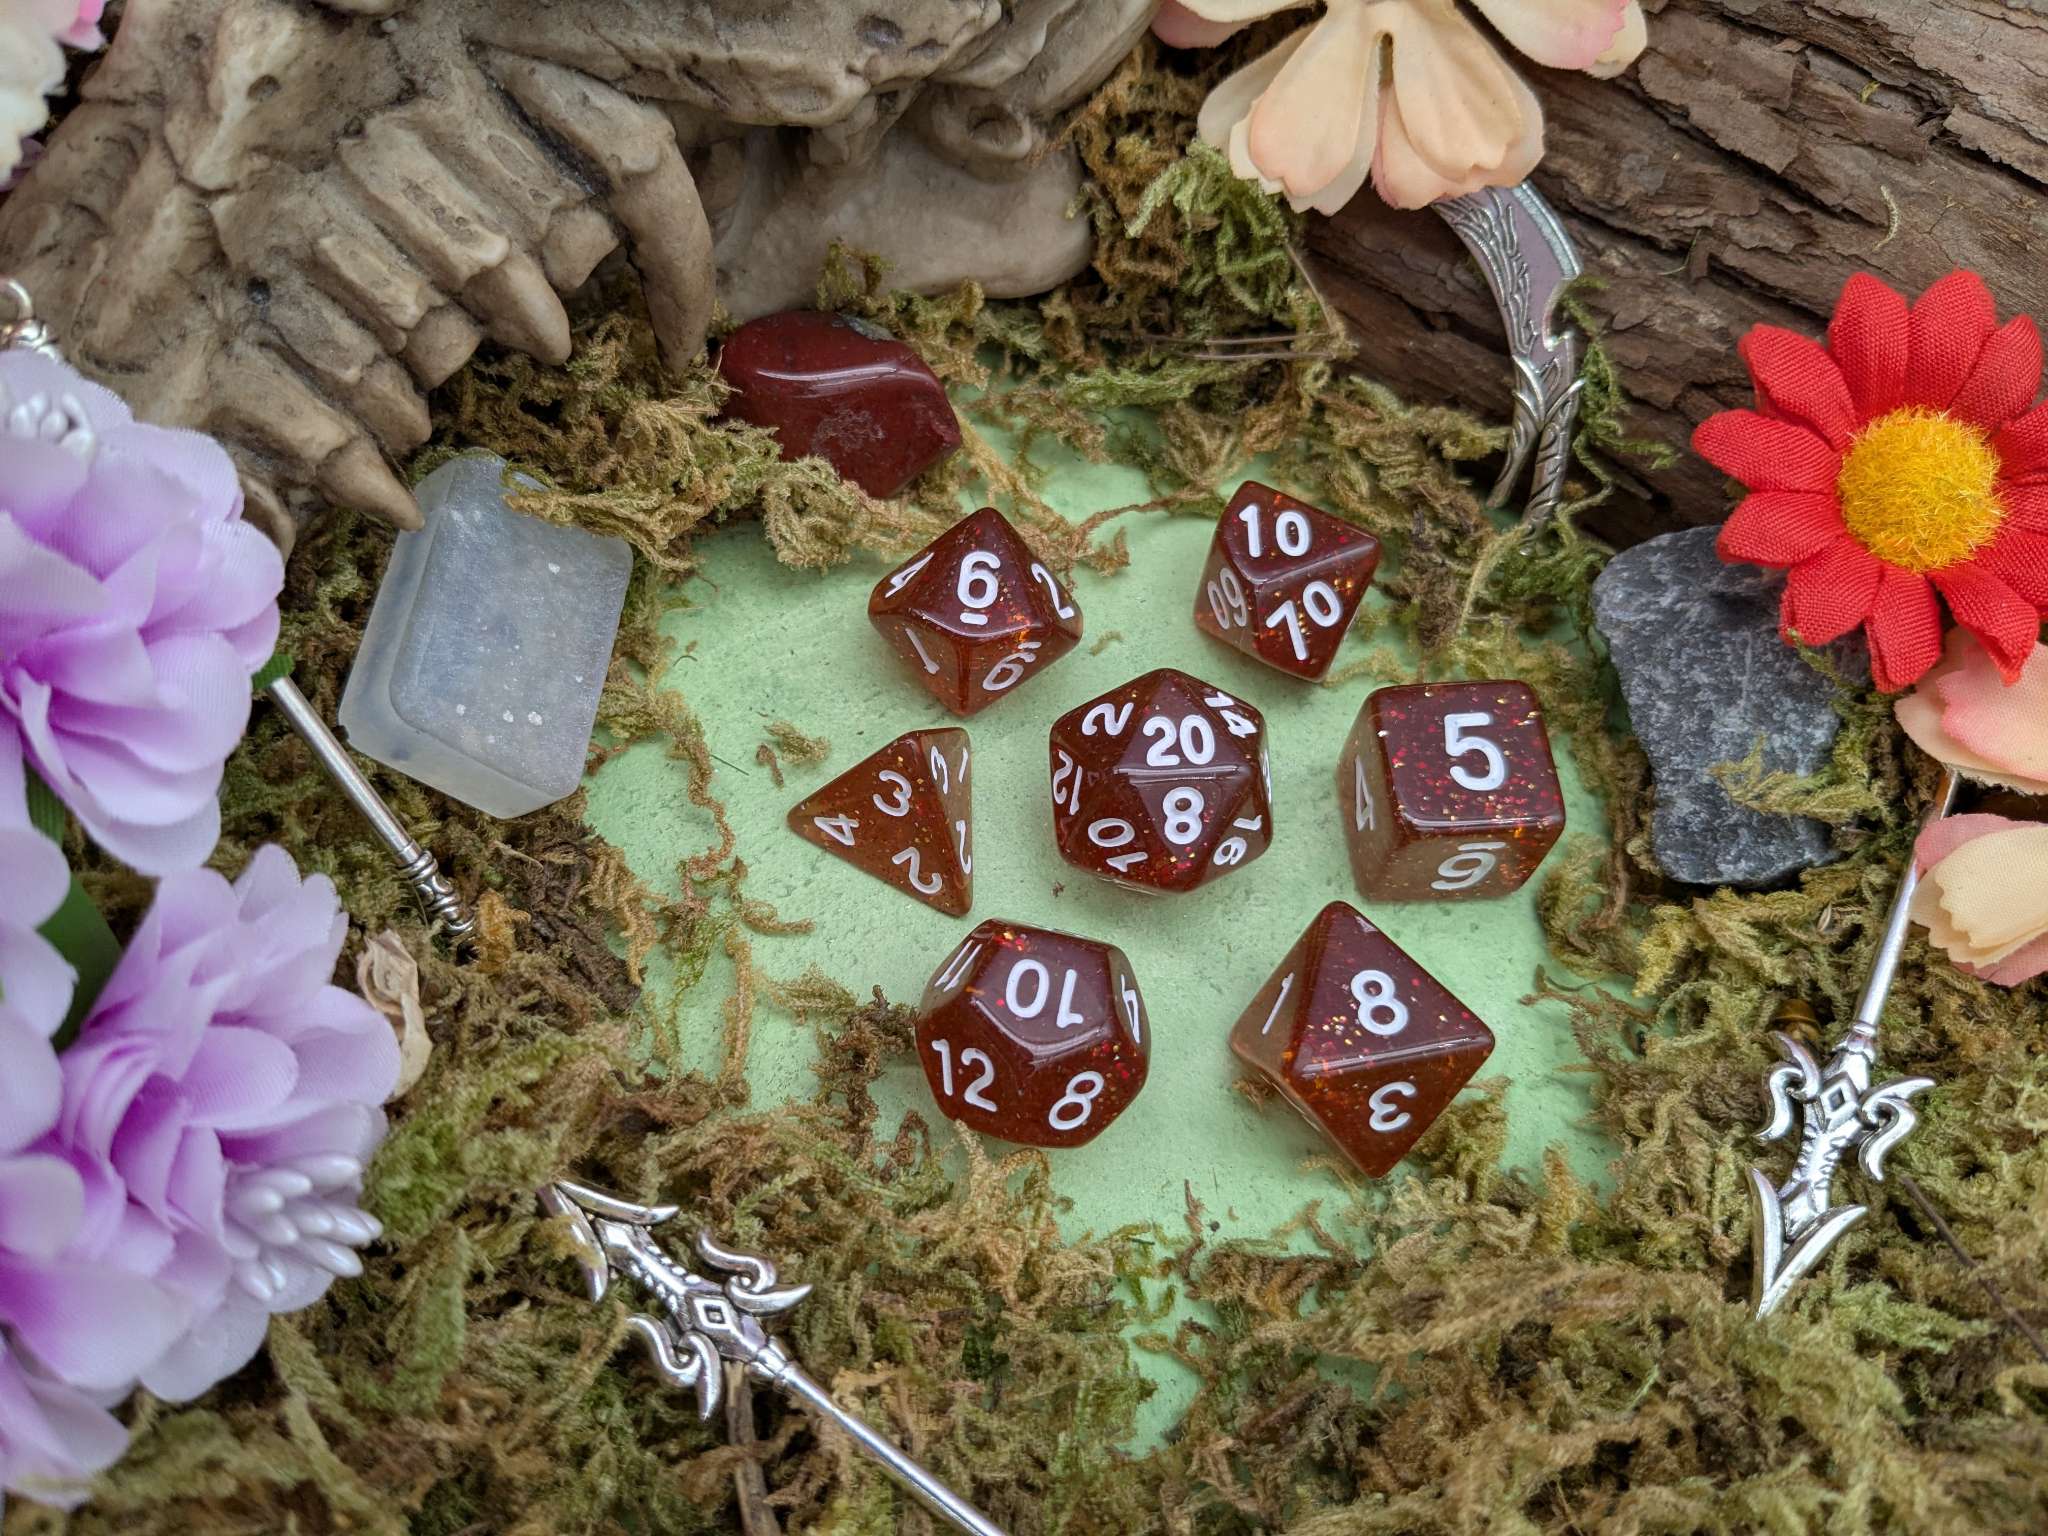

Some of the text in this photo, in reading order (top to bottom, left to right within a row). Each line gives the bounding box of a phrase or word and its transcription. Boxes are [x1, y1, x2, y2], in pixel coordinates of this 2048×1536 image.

[1238, 504, 1312, 558] 10
[885, 552, 934, 598] 4
[957, 551, 1000, 625] 6
[1031, 563, 1074, 619] 2
[1265, 581, 1342, 661] 70
[1082, 702, 1134, 736] 2
[1143, 714, 1215, 766] 20
[1204, 692, 1257, 738] 14
[1444, 712, 1505, 791] 5
[873, 770, 912, 817] 3
[1162, 786, 1205, 845] 8
[1355, 755, 1376, 832] 4
[814, 813, 860, 846] 4
[1088, 817, 1148, 872] 10
[892, 846, 943, 895] 2
[1005, 959, 1083, 1028] 10
[1262, 972, 1294, 1034] 1
[1350, 970, 1409, 1035] 8
[932, 1039, 997, 1112] 12
[1049, 1071, 1104, 1130] 8
[1369, 1082, 1417, 1132] 3
